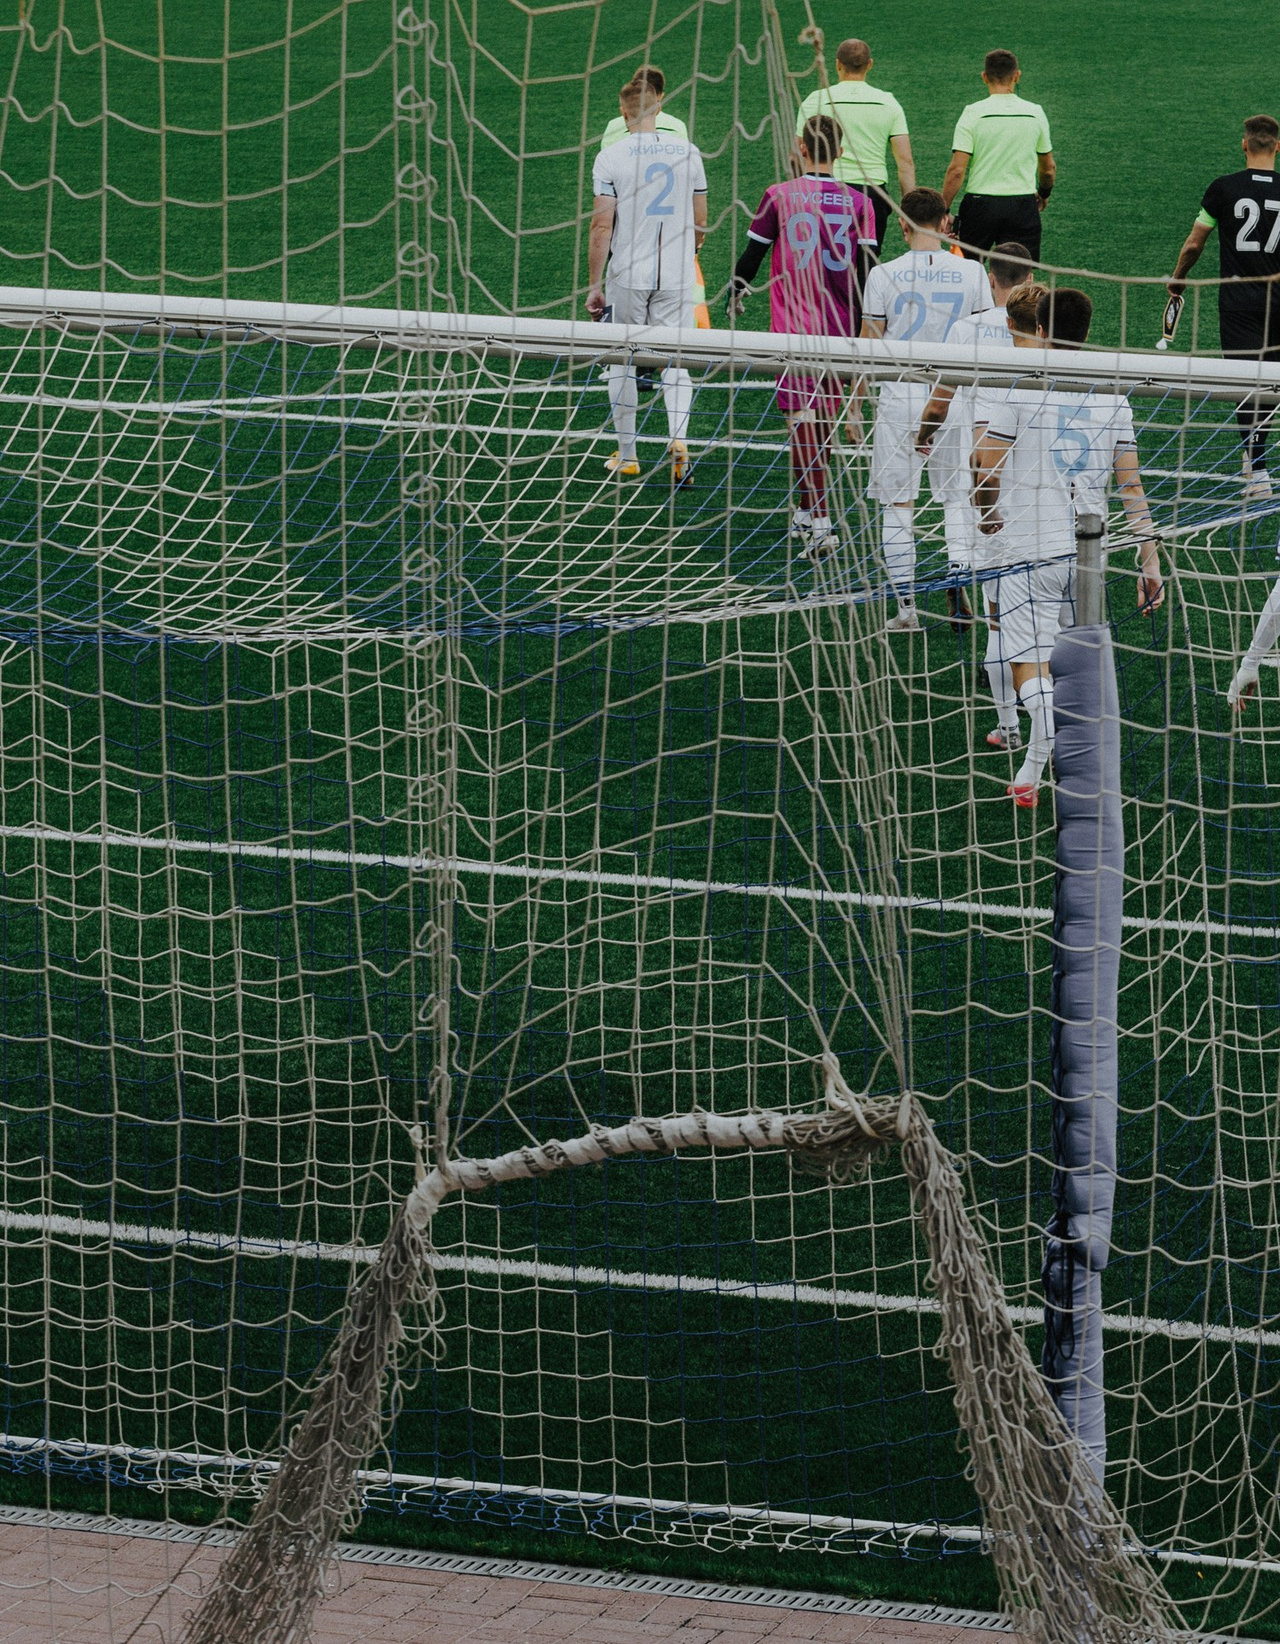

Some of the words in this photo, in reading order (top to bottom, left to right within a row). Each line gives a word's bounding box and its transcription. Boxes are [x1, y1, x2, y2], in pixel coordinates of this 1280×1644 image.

[629, 144, 685, 157] ЖИРОВ
[645, 162, 675, 216] 2
[787, 212, 852, 272] 93
[893, 270, 963, 284] КОЧИЕВ
[894, 291, 965, 344] 27
[1053, 405, 1091, 477] 5
